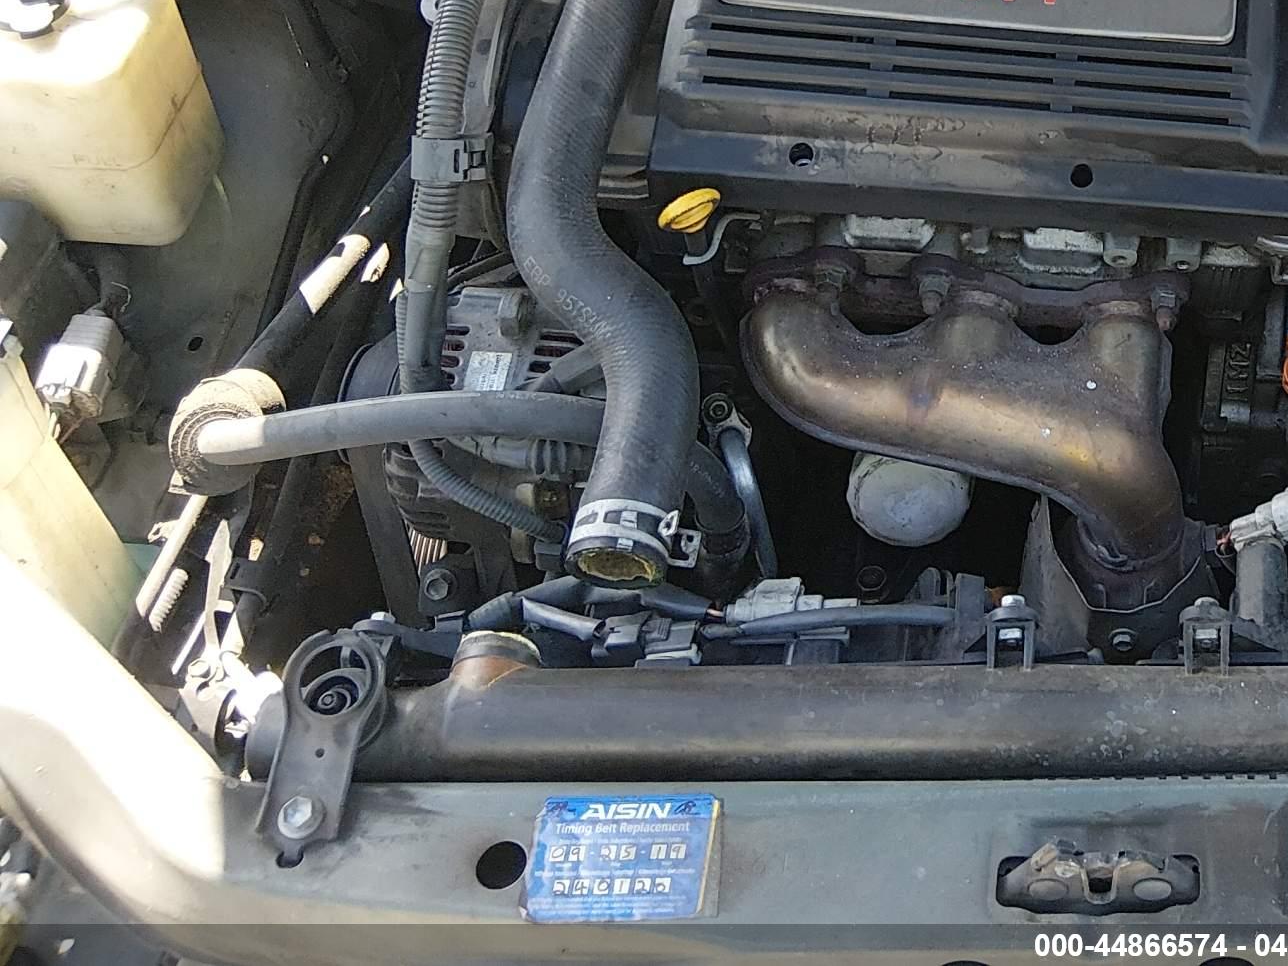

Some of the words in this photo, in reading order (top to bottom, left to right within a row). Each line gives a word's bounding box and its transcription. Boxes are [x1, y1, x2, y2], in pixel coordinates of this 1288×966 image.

[580, 802, 671, 820] AISIN
[556, 822, 592, 835] Timing
[595, 822, 616, 834] Belt
[619, 821, 690, 835] Replacement
